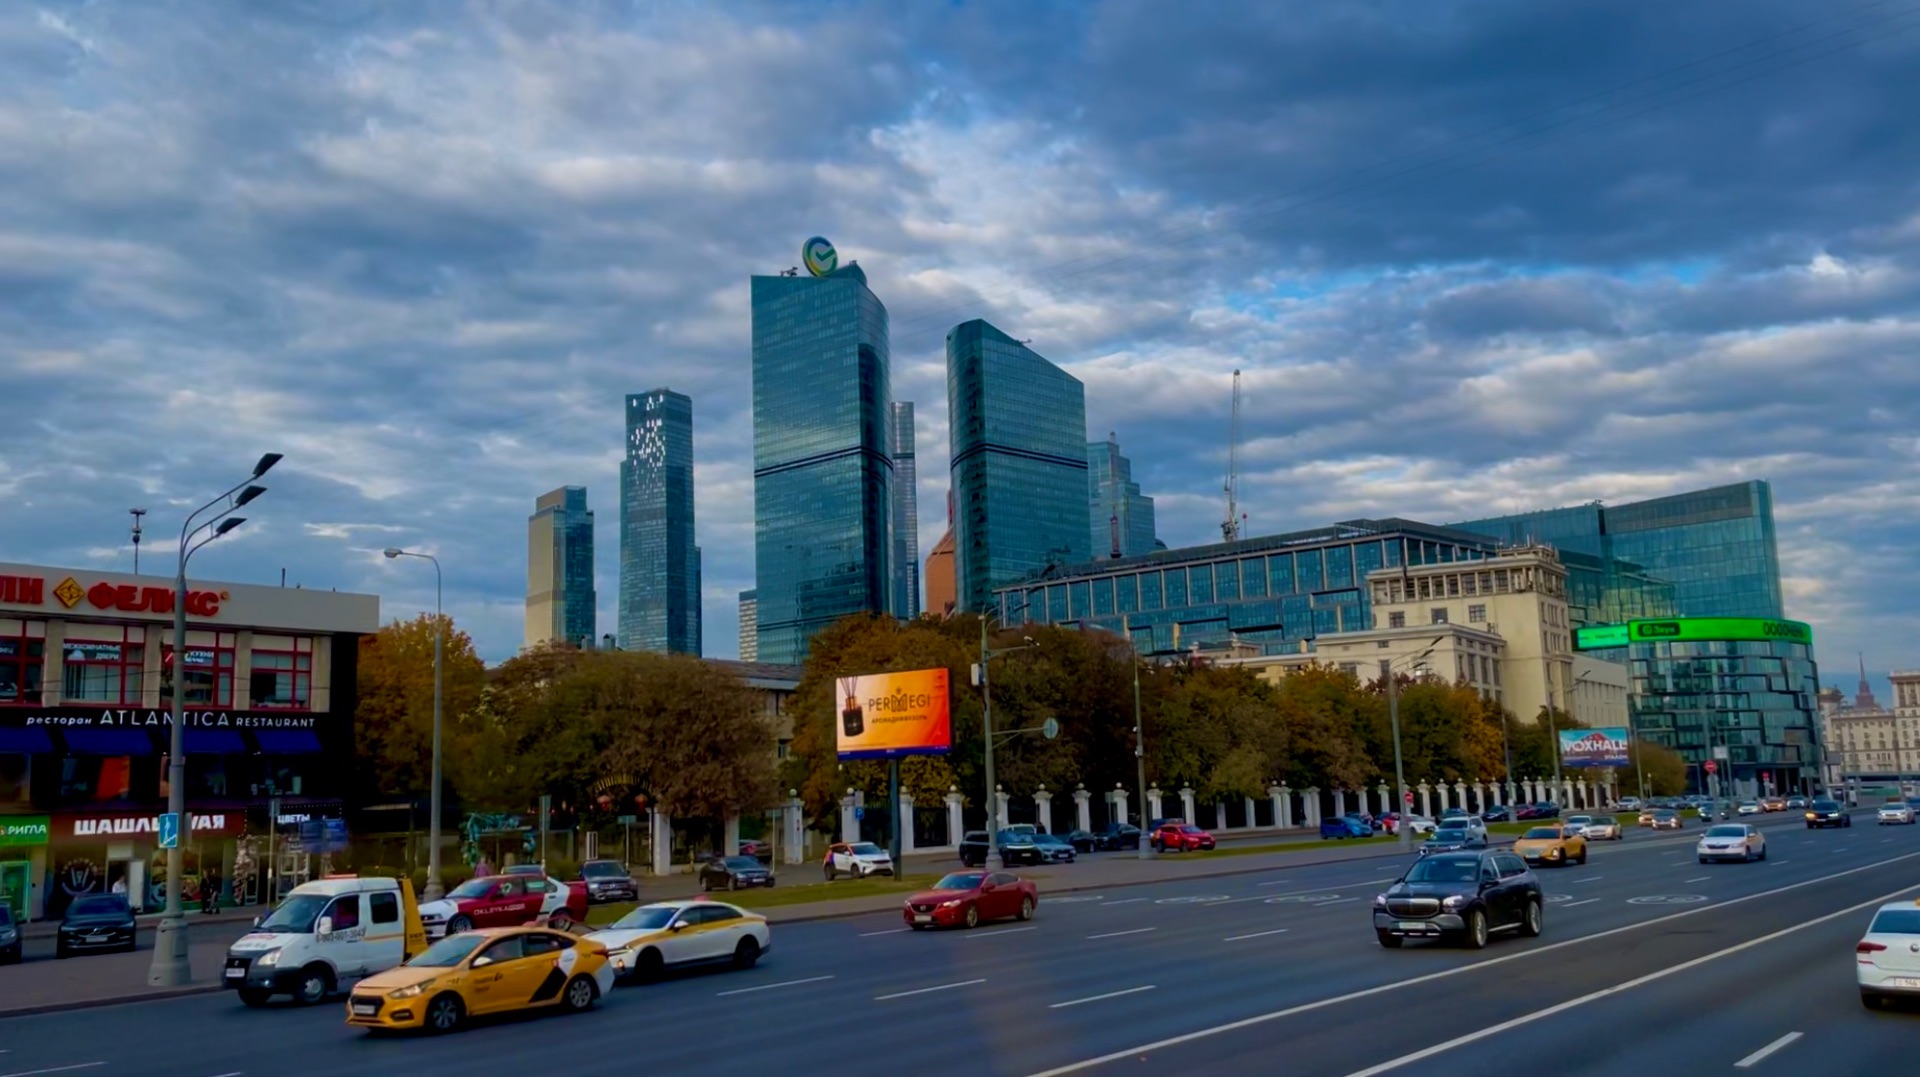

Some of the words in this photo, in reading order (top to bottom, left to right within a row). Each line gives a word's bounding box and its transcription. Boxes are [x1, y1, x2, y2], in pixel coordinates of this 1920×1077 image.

[87, 582, 219, 616] ФЕЛИКС
[95, 652, 119, 660] ДВЕРИ
[26, 716, 92, 726] ресторан
[100, 709, 229, 727] ATLANTICA
[236, 717, 315, 728] RESTAURANT
[1562, 739, 1627, 752] VOXHALL
[277, 813, 311, 824] ЦВЕТЫ
[7, 824, 47, 835] РИГЛА
